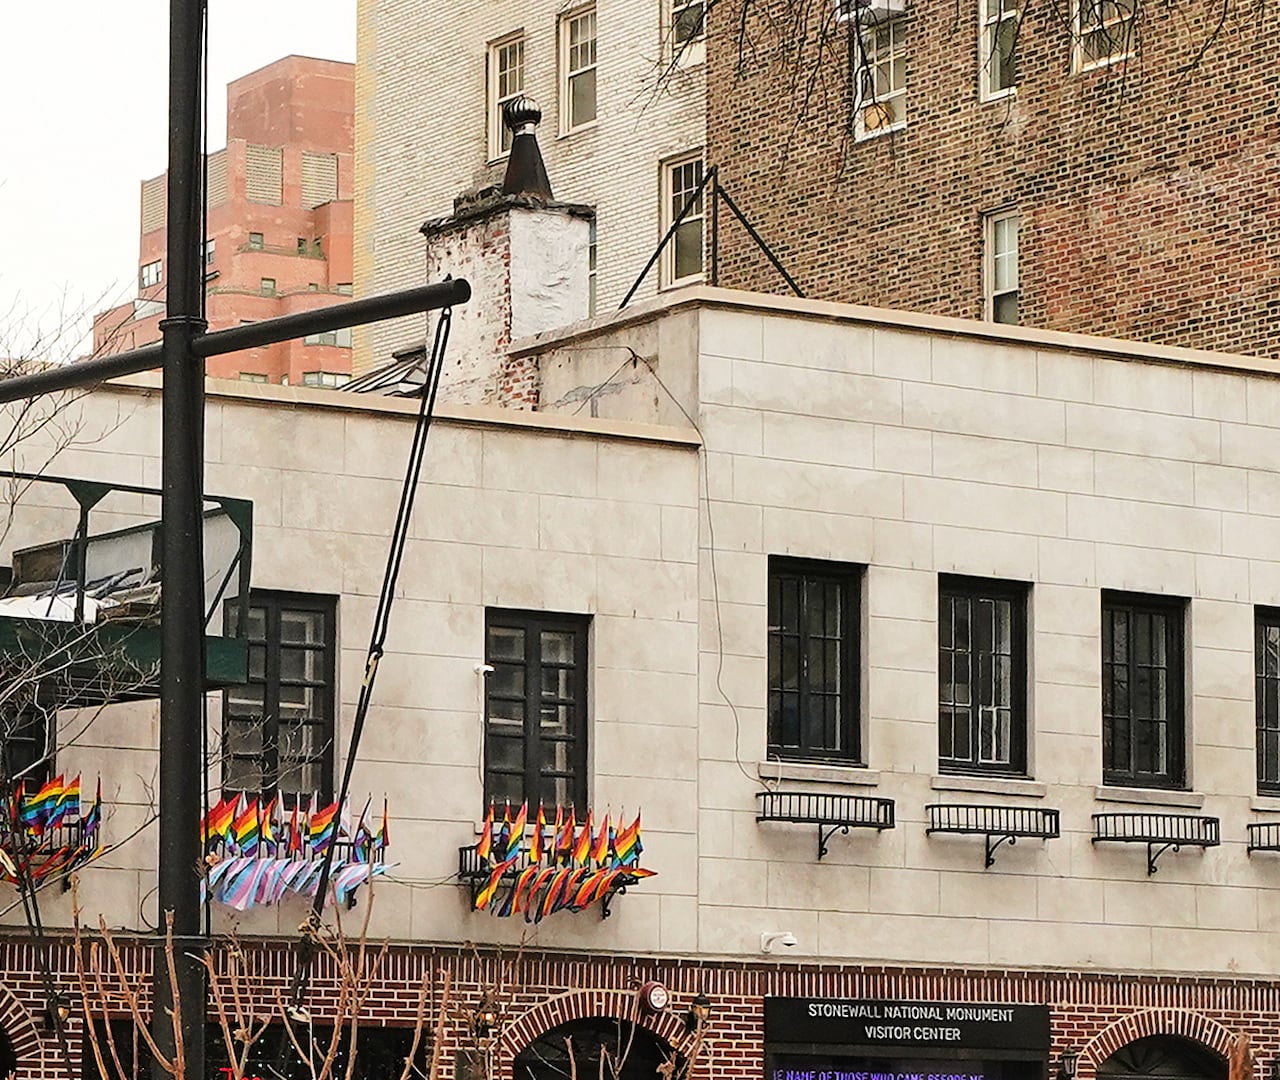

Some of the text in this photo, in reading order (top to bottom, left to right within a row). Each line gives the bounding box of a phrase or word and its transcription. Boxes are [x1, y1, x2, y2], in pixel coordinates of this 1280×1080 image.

[808, 1003, 1014, 1023] STONEWALL NATIONAL MONUMENT
[864, 1025, 961, 1041] VISITOR CENTER
